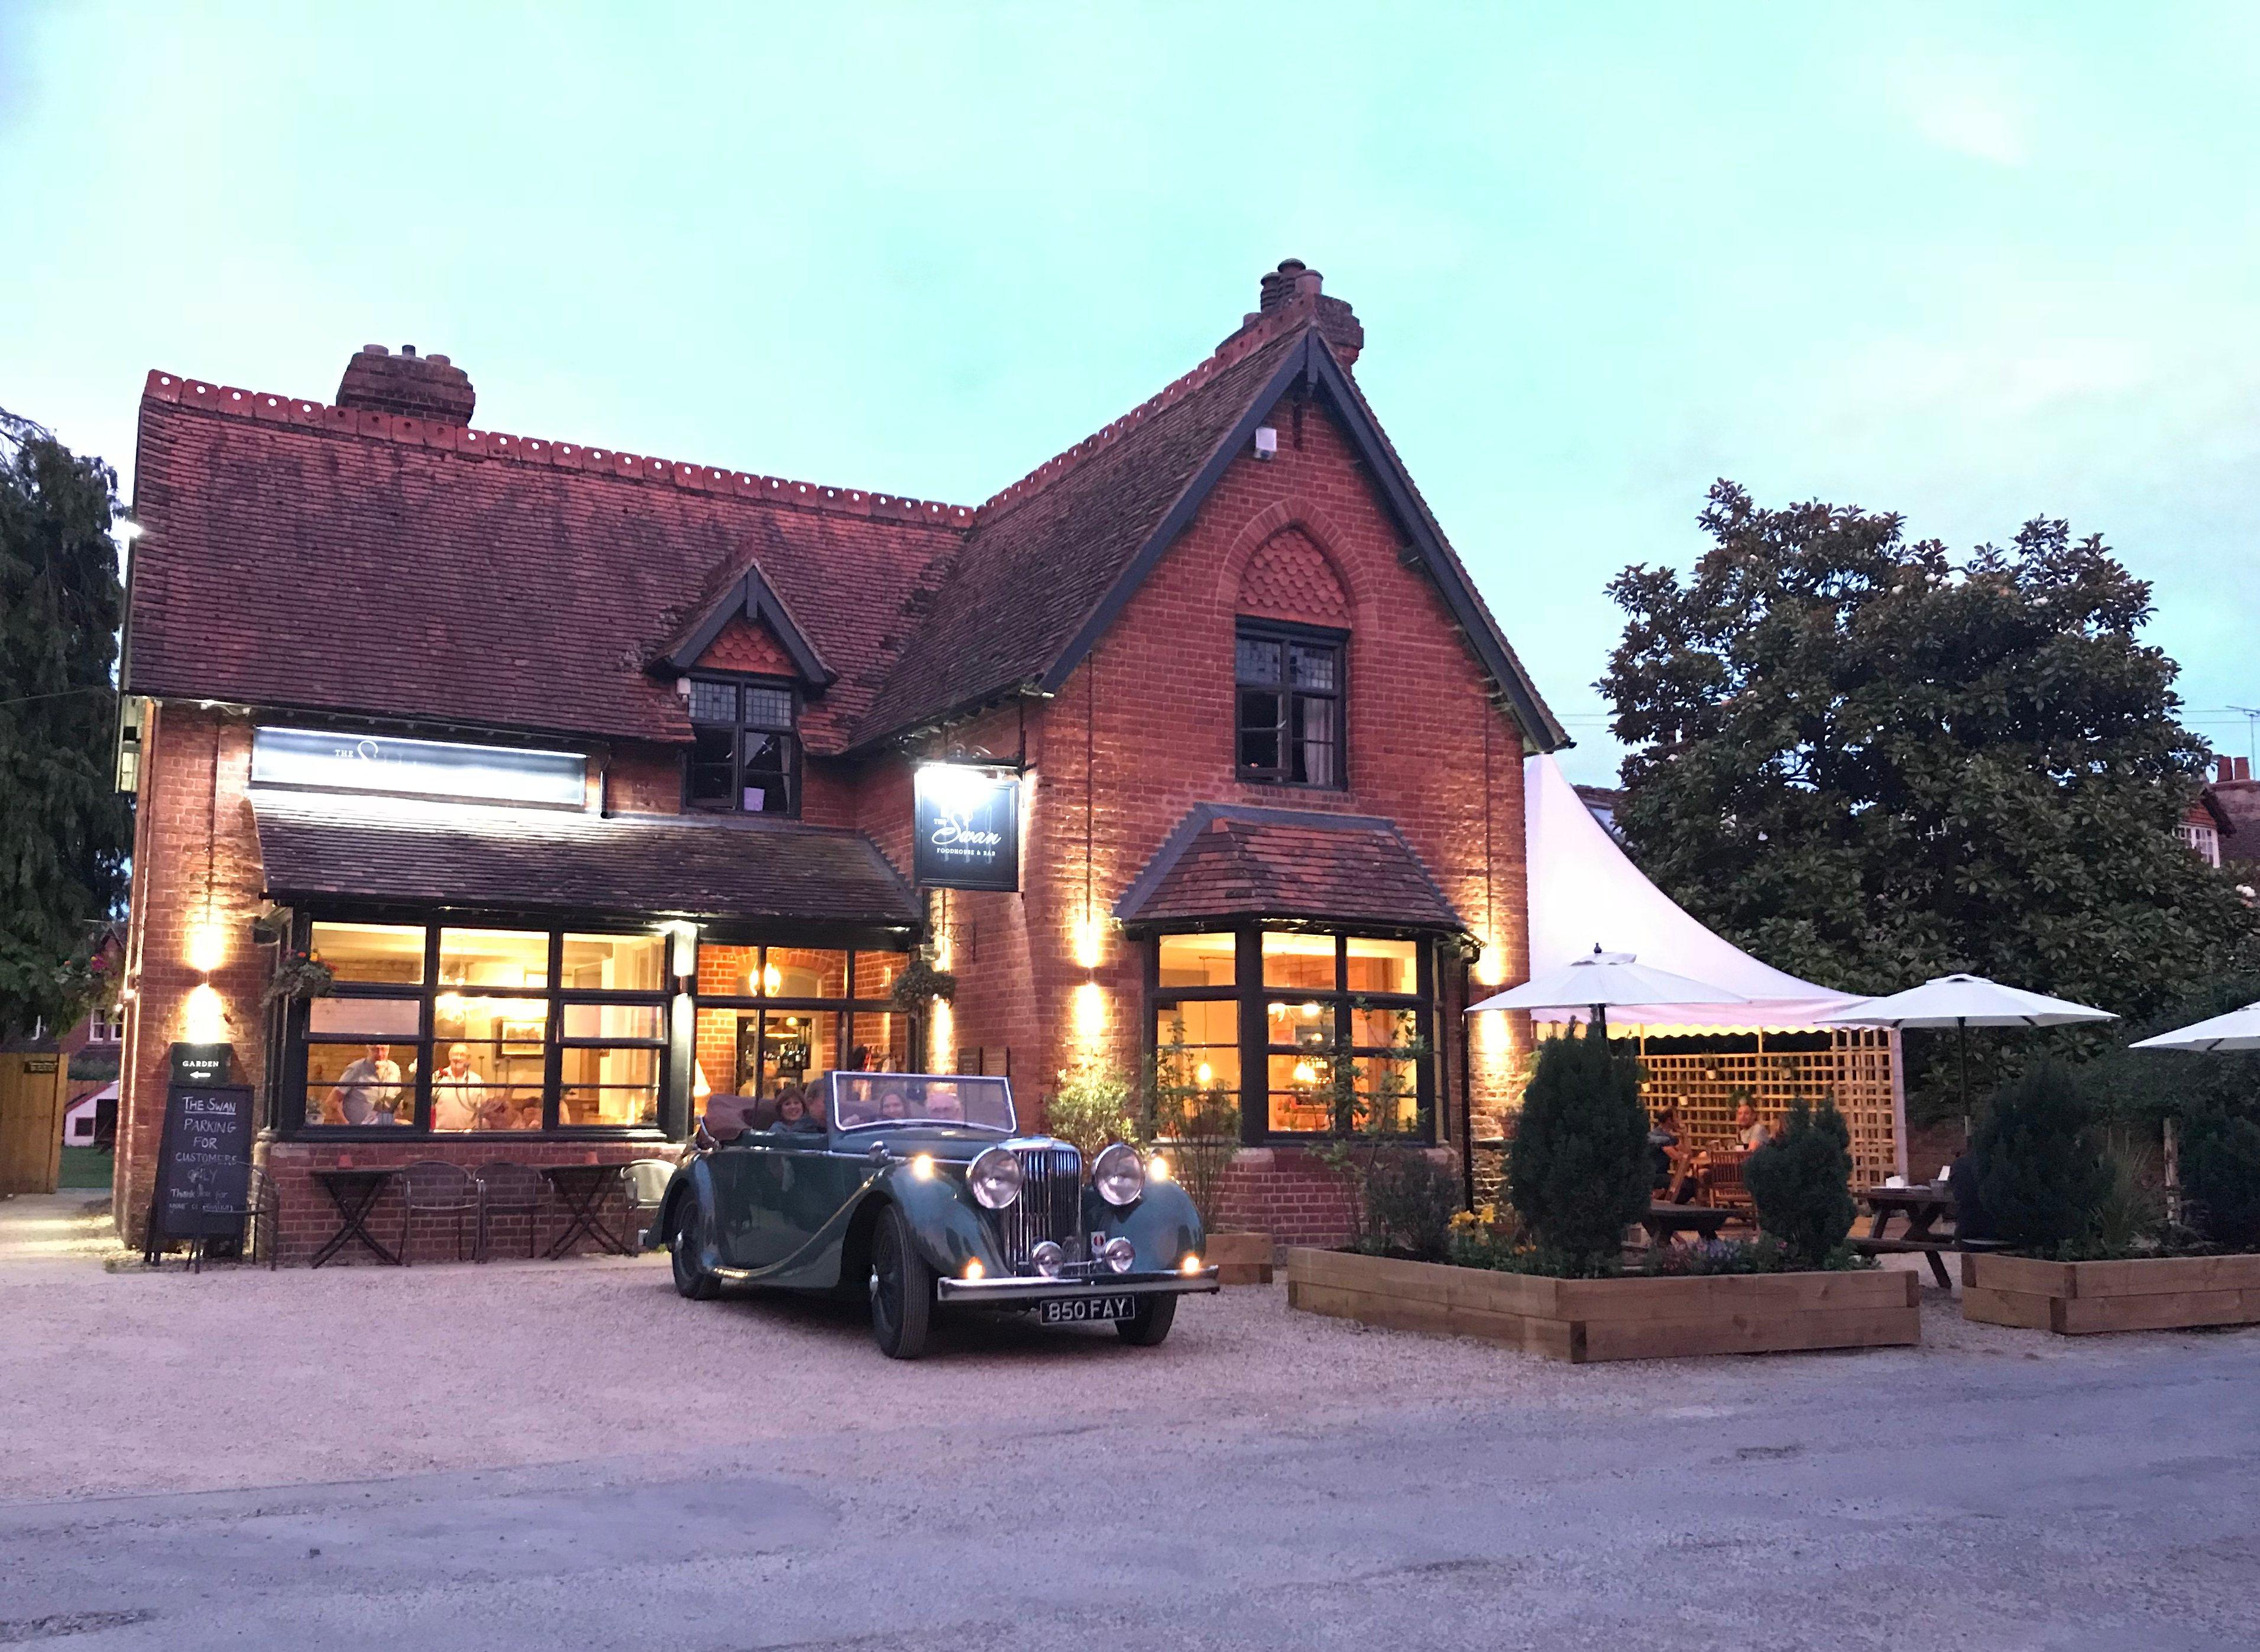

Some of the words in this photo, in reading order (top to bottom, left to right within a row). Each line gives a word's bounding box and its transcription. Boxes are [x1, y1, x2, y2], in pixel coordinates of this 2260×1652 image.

[335, 749, 354, 758] THE
[931, 813, 1002, 846] Swan
[937, 847, 974, 856] FOODHOUSE
[182, 1096, 204, 1110] THE
[206, 1097, 237, 1113] SWAN
[183, 1118, 237, 1133] PARKING
[193, 1136, 218, 1149] FOR
[1048, 1301, 1086, 1321] 850
[1090, 1297, 1127, 1319] FAY
